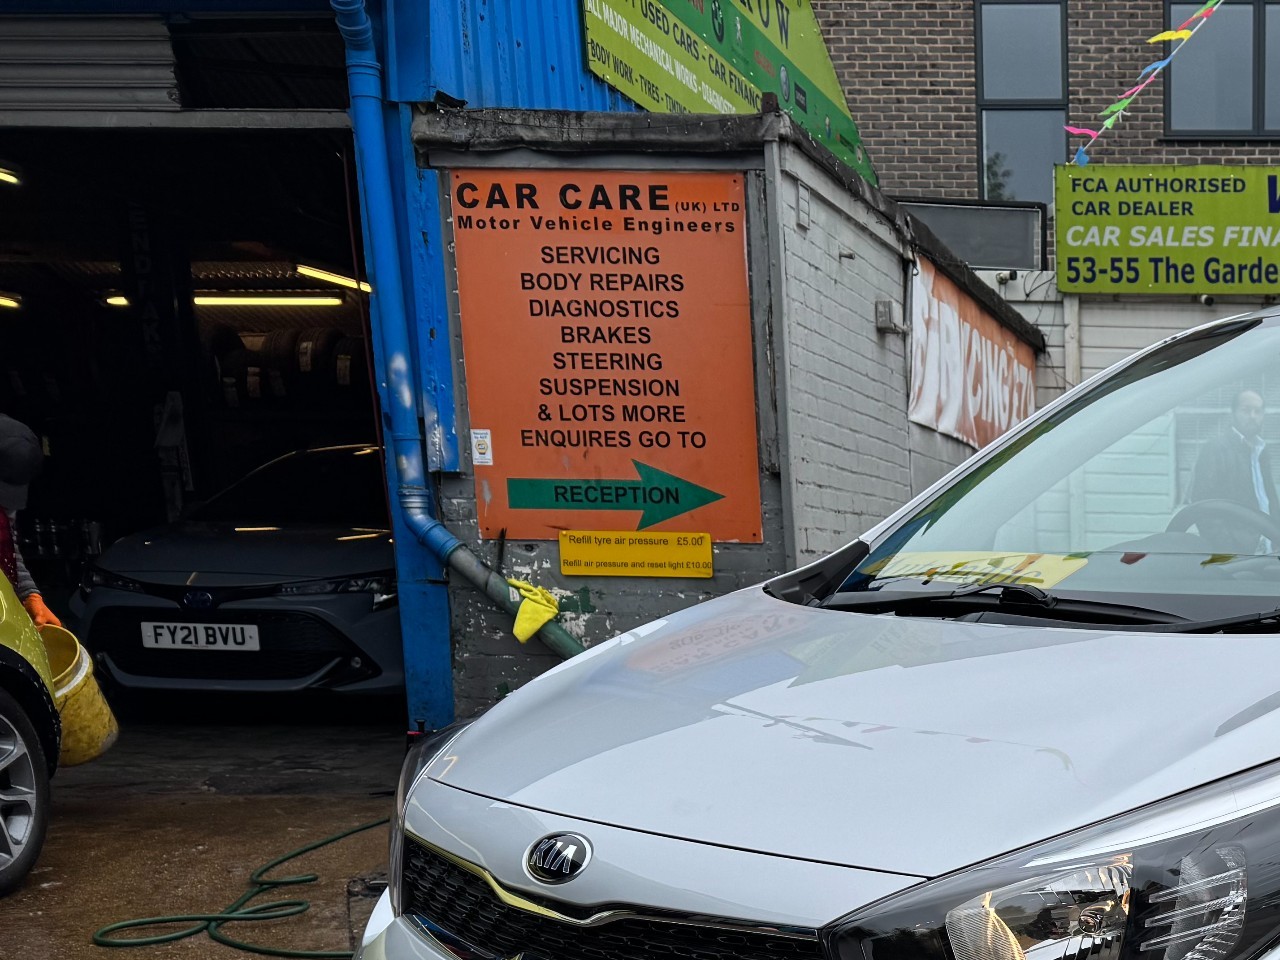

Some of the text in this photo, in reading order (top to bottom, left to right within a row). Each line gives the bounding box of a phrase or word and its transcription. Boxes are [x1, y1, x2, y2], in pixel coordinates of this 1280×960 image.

[602, 2, 630, 41] MAJOR
[629, 24, 675, 77] MECHANICAL
[674, 58, 699, 95] WORKS
[640, 0, 670, 36] USED
[673, 22, 700, 61] CARS
[708, 53, 727, 86] CAR
[729, 70, 762, 113] FINANC
[590, 38, 611, 69] BODY
[612, 53, 635, 86] WORK
[639, 73, 660, 104] TYRES
[1071, 178, 1247, 193] FCA AUTHORISED
[456, 182, 740, 213] CAR CARE (UK) LTD
[1071, 201, 1194, 216] CAR DEALER
[457, 215, 735, 235] Motor Vehicle Engineers
[1066, 226, 1120, 247] CAR
[1128, 226, 1215, 247] SALES
[540, 246, 660, 265] SERVICING
[1066, 257, 1140, 284] 53-55
[1149, 256, 1195, 284] The
[520, 273, 684, 292] BODY REPAIRS
[529, 299, 680, 318] DIAGNOSTICS
[561, 326, 651, 344] BRAKES
[553, 352, 663, 370] STEERING
[539, 378, 680, 396] SUSPENSION
[537, 404, 686, 423] & LOTS MORE
[520, 429, 706, 449] ENQUIRES GO TO
[554, 485, 680, 505] RECEPTION
[568, 534, 703, 549] Refill tyre air pressure £5.00
[562, 559, 712, 570] Refill air pressure and reset light £10.00
[153, 625, 246, 646] FY21 BVU
[529, 839, 578, 873] KIA
